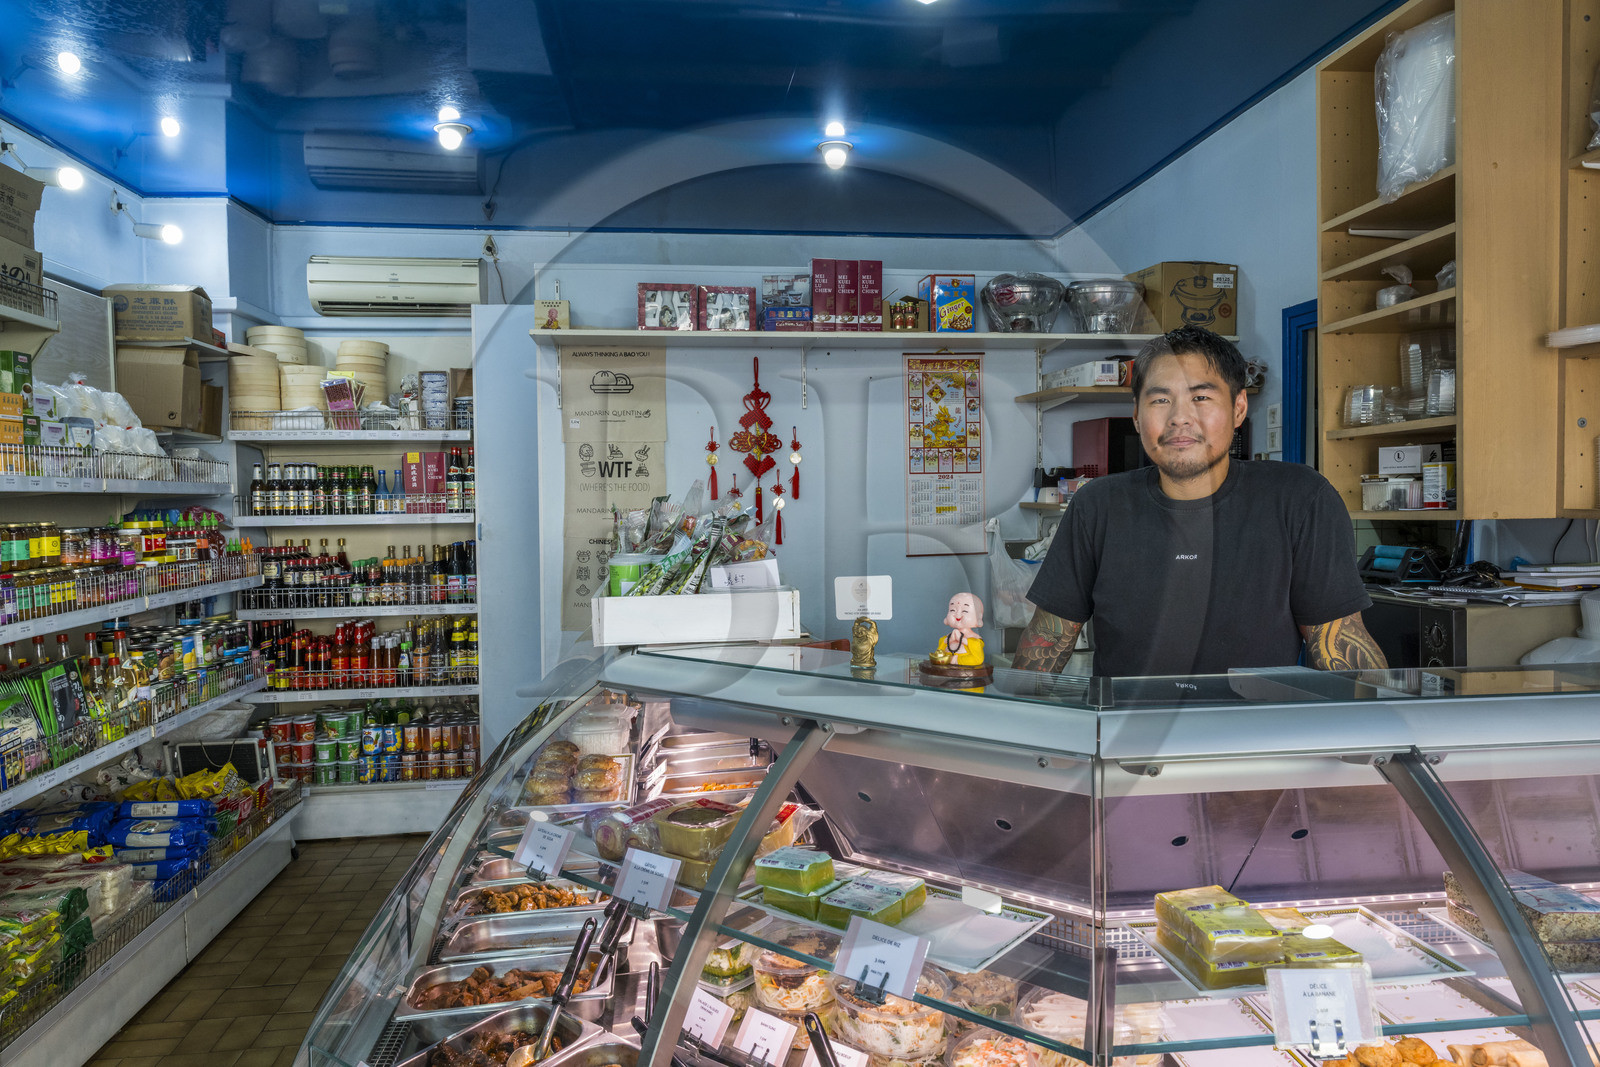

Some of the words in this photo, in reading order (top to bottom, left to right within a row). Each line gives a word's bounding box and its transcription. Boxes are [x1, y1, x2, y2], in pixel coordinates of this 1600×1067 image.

[939, 301, 966, 318] Ginger
[598, 461, 633, 478] WTF
[613, 483, 627, 492] THE
[628, 482, 650, 493] FOOD)
[1309, 982, 1327, 990] DÉLICE
